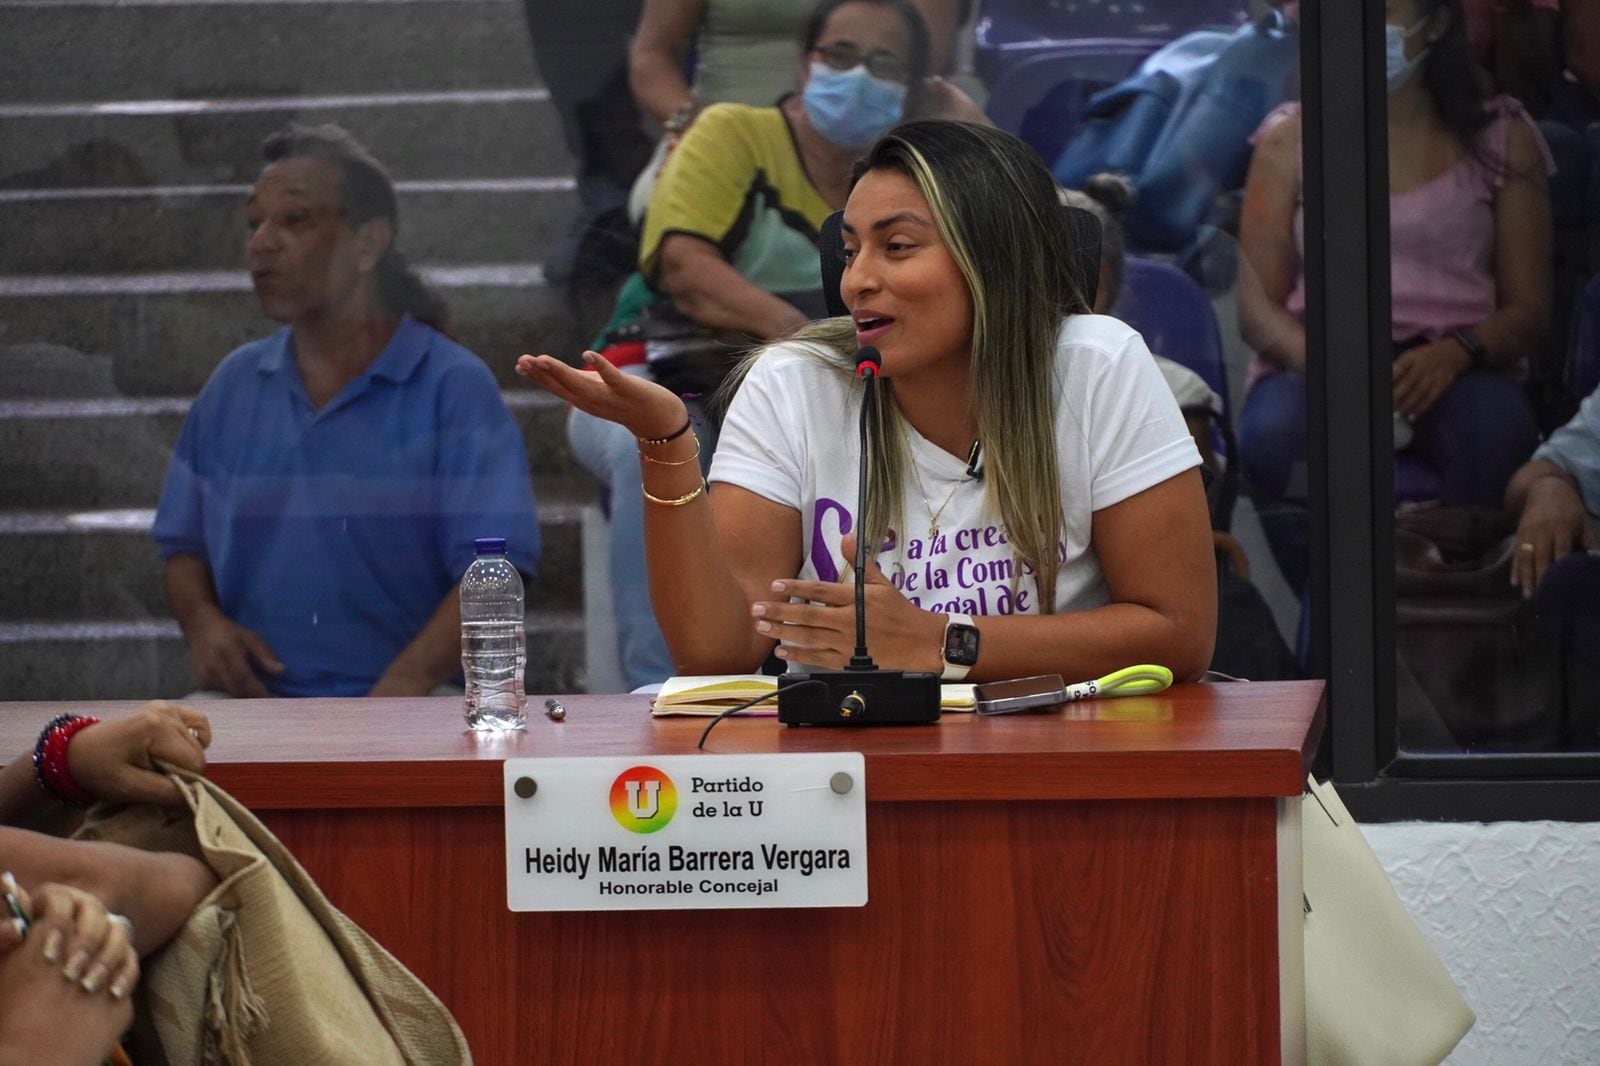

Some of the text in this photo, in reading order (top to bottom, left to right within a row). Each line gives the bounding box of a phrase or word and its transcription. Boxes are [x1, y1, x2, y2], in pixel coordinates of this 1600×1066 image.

[907, 539, 923, 559] a
[929, 529, 947, 556] la
[891, 562, 918, 591] de
[925, 561, 949, 590] la
[995, 584, 1031, 615] de
[625, 780, 661, 819] U
[691, 777, 763, 793] Partido
[692, 801, 764, 818] de la U
[525, 843, 851, 880] Heidy María Barrera Vergara
[600, 879, 778, 896] Honorable Concejal
